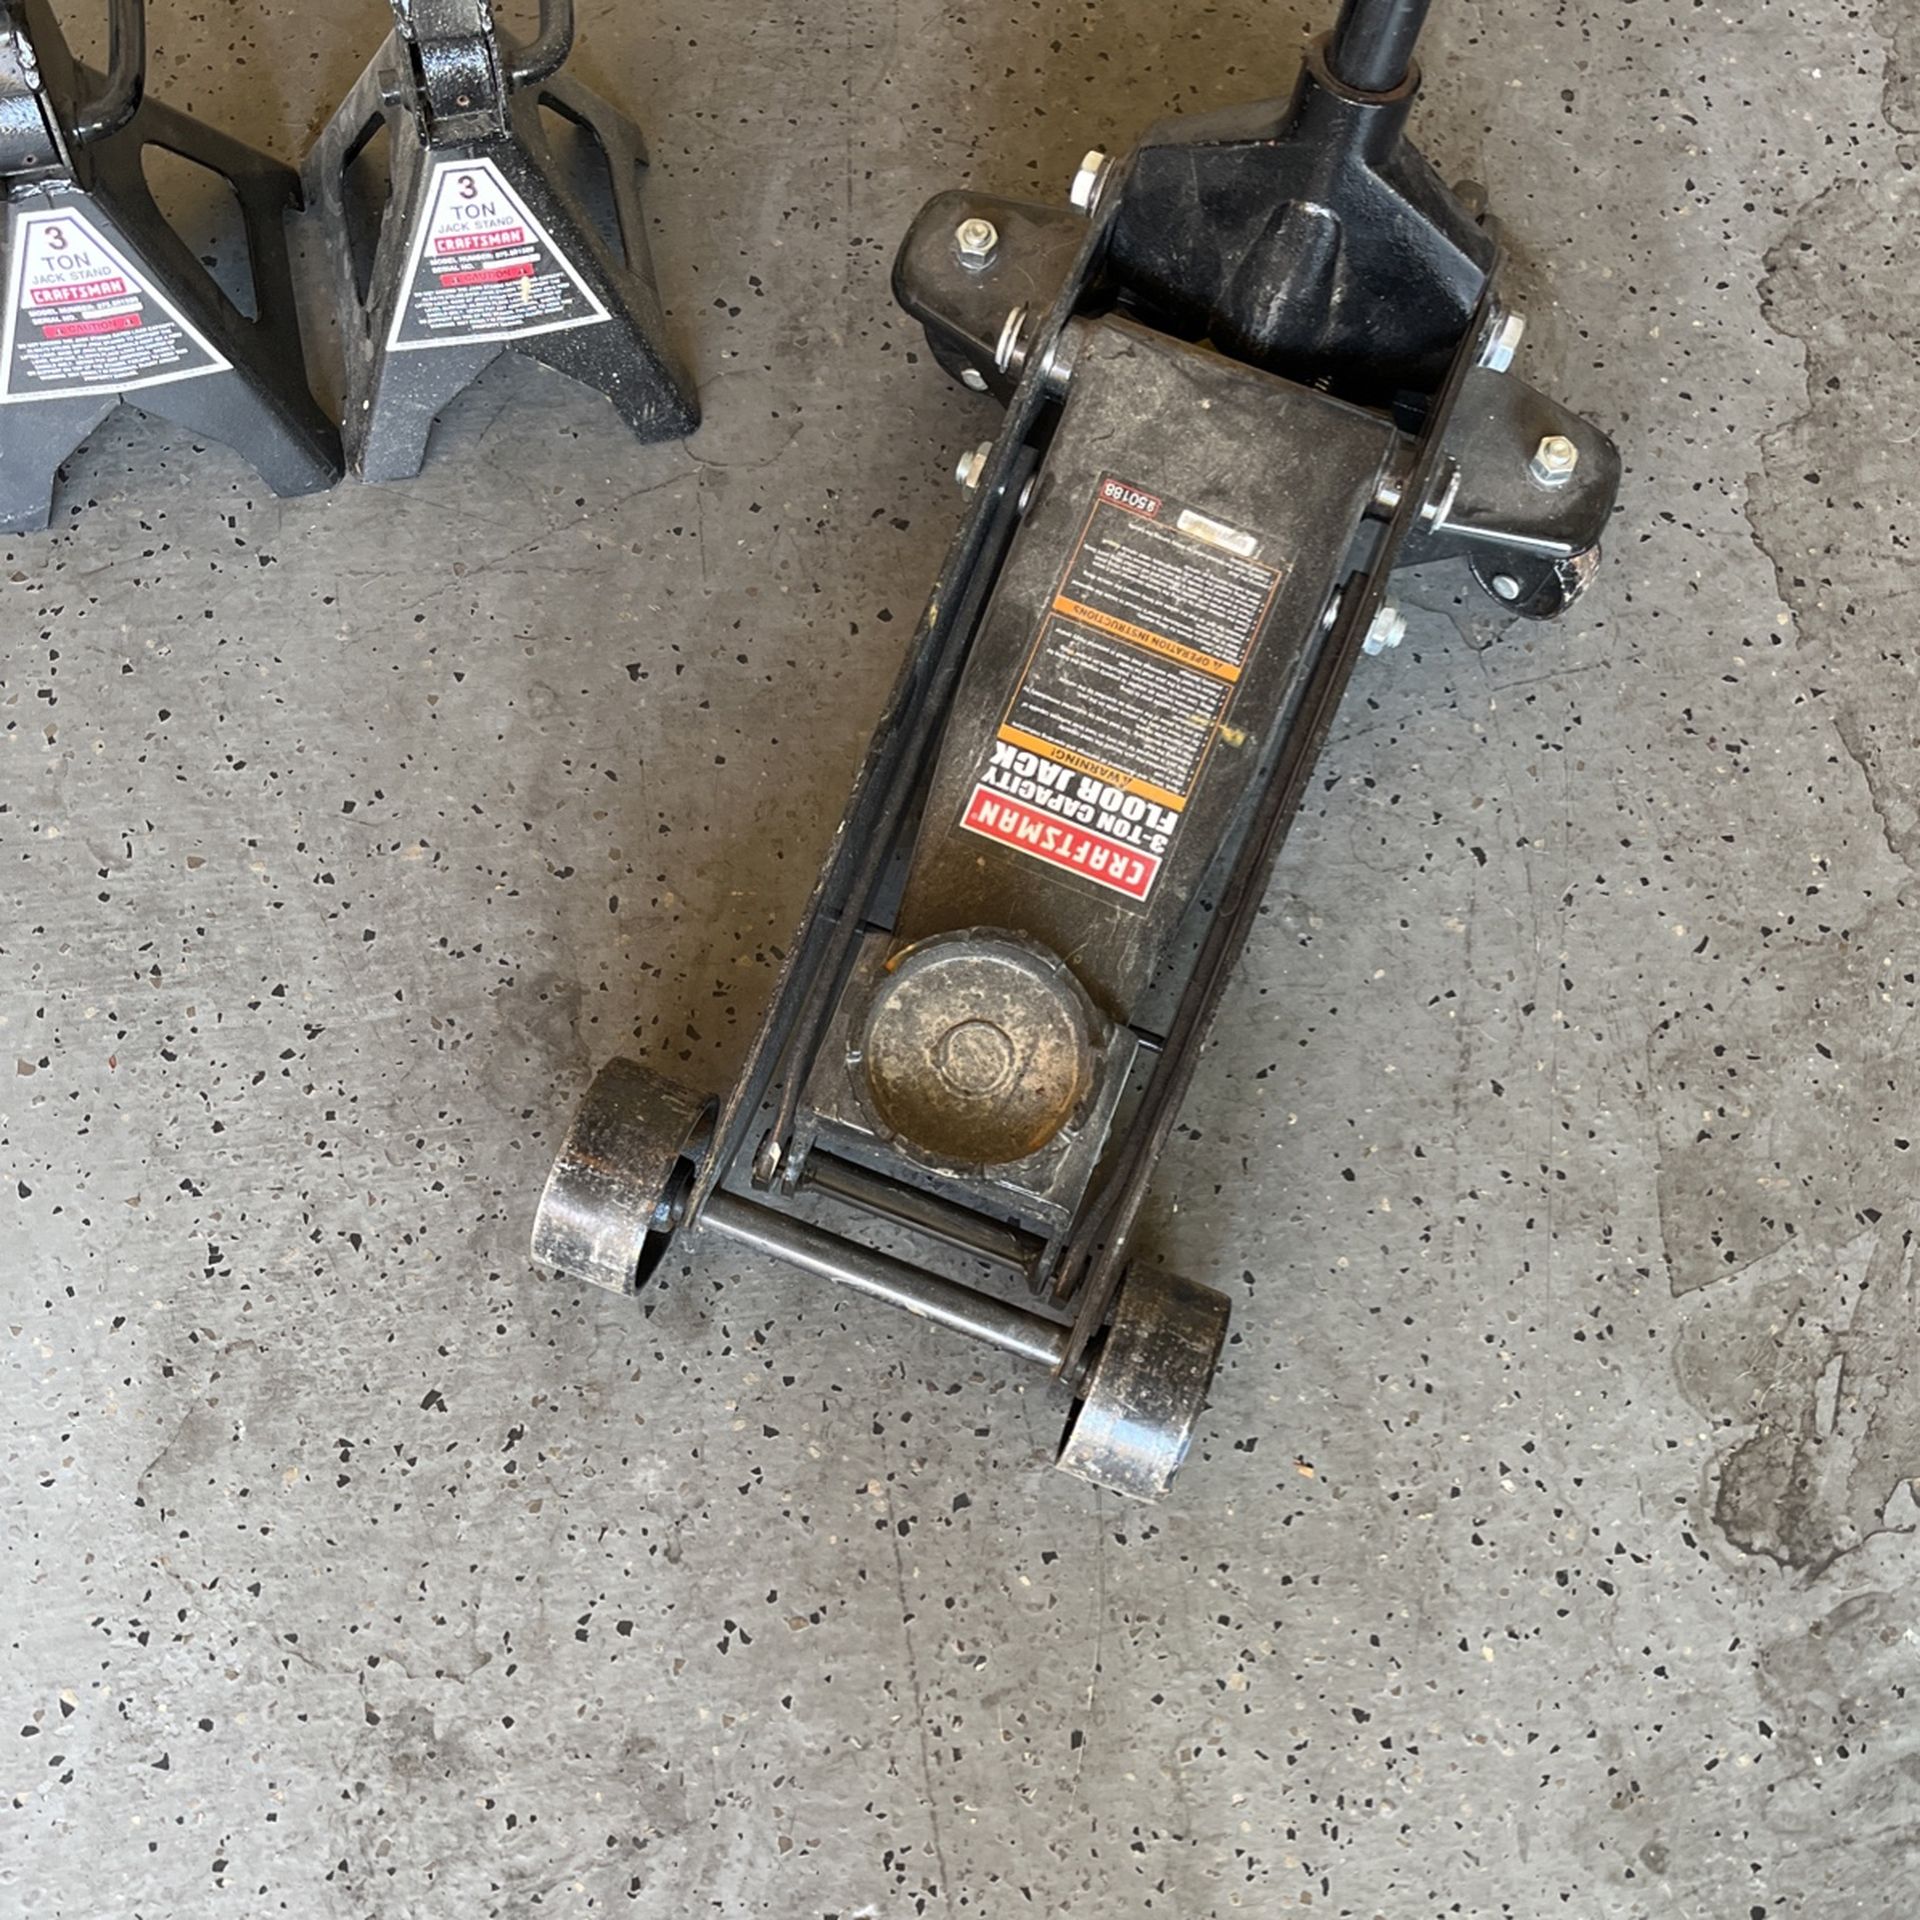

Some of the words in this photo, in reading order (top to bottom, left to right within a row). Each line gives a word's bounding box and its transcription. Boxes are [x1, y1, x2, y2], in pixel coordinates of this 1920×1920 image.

[457, 175, 478, 199] 3
[451, 202, 496, 221] TON
[437, 222, 470, 234] JACK
[474, 216, 514, 230] STAND
[44, 226, 68, 250] 3
[437, 230, 522, 252] CRAFTSMAN
[41, 252, 92, 272] TON
[32, 273, 65, 285] JACK
[69, 266, 112, 281] STAND
[464, 270, 511, 282] CAUTION
[33, 280, 123, 303] CRAFTSMAN
[67, 320, 117, 333] CAUTION
[1071, 604, 1150, 642] INSTRUCTIONS
[1149, 636, 1210, 666] OPERATION
[987, 740, 1076, 792] JACK
[1049, 747, 1119, 782] WARNING!
[980, 765, 1096, 824] CAPACITY
[1074, 780, 1180, 835] FLOOR
[975, 798, 1146, 886] CRAFTSMAN
[1094, 810, 1170, 855] 3-TON
